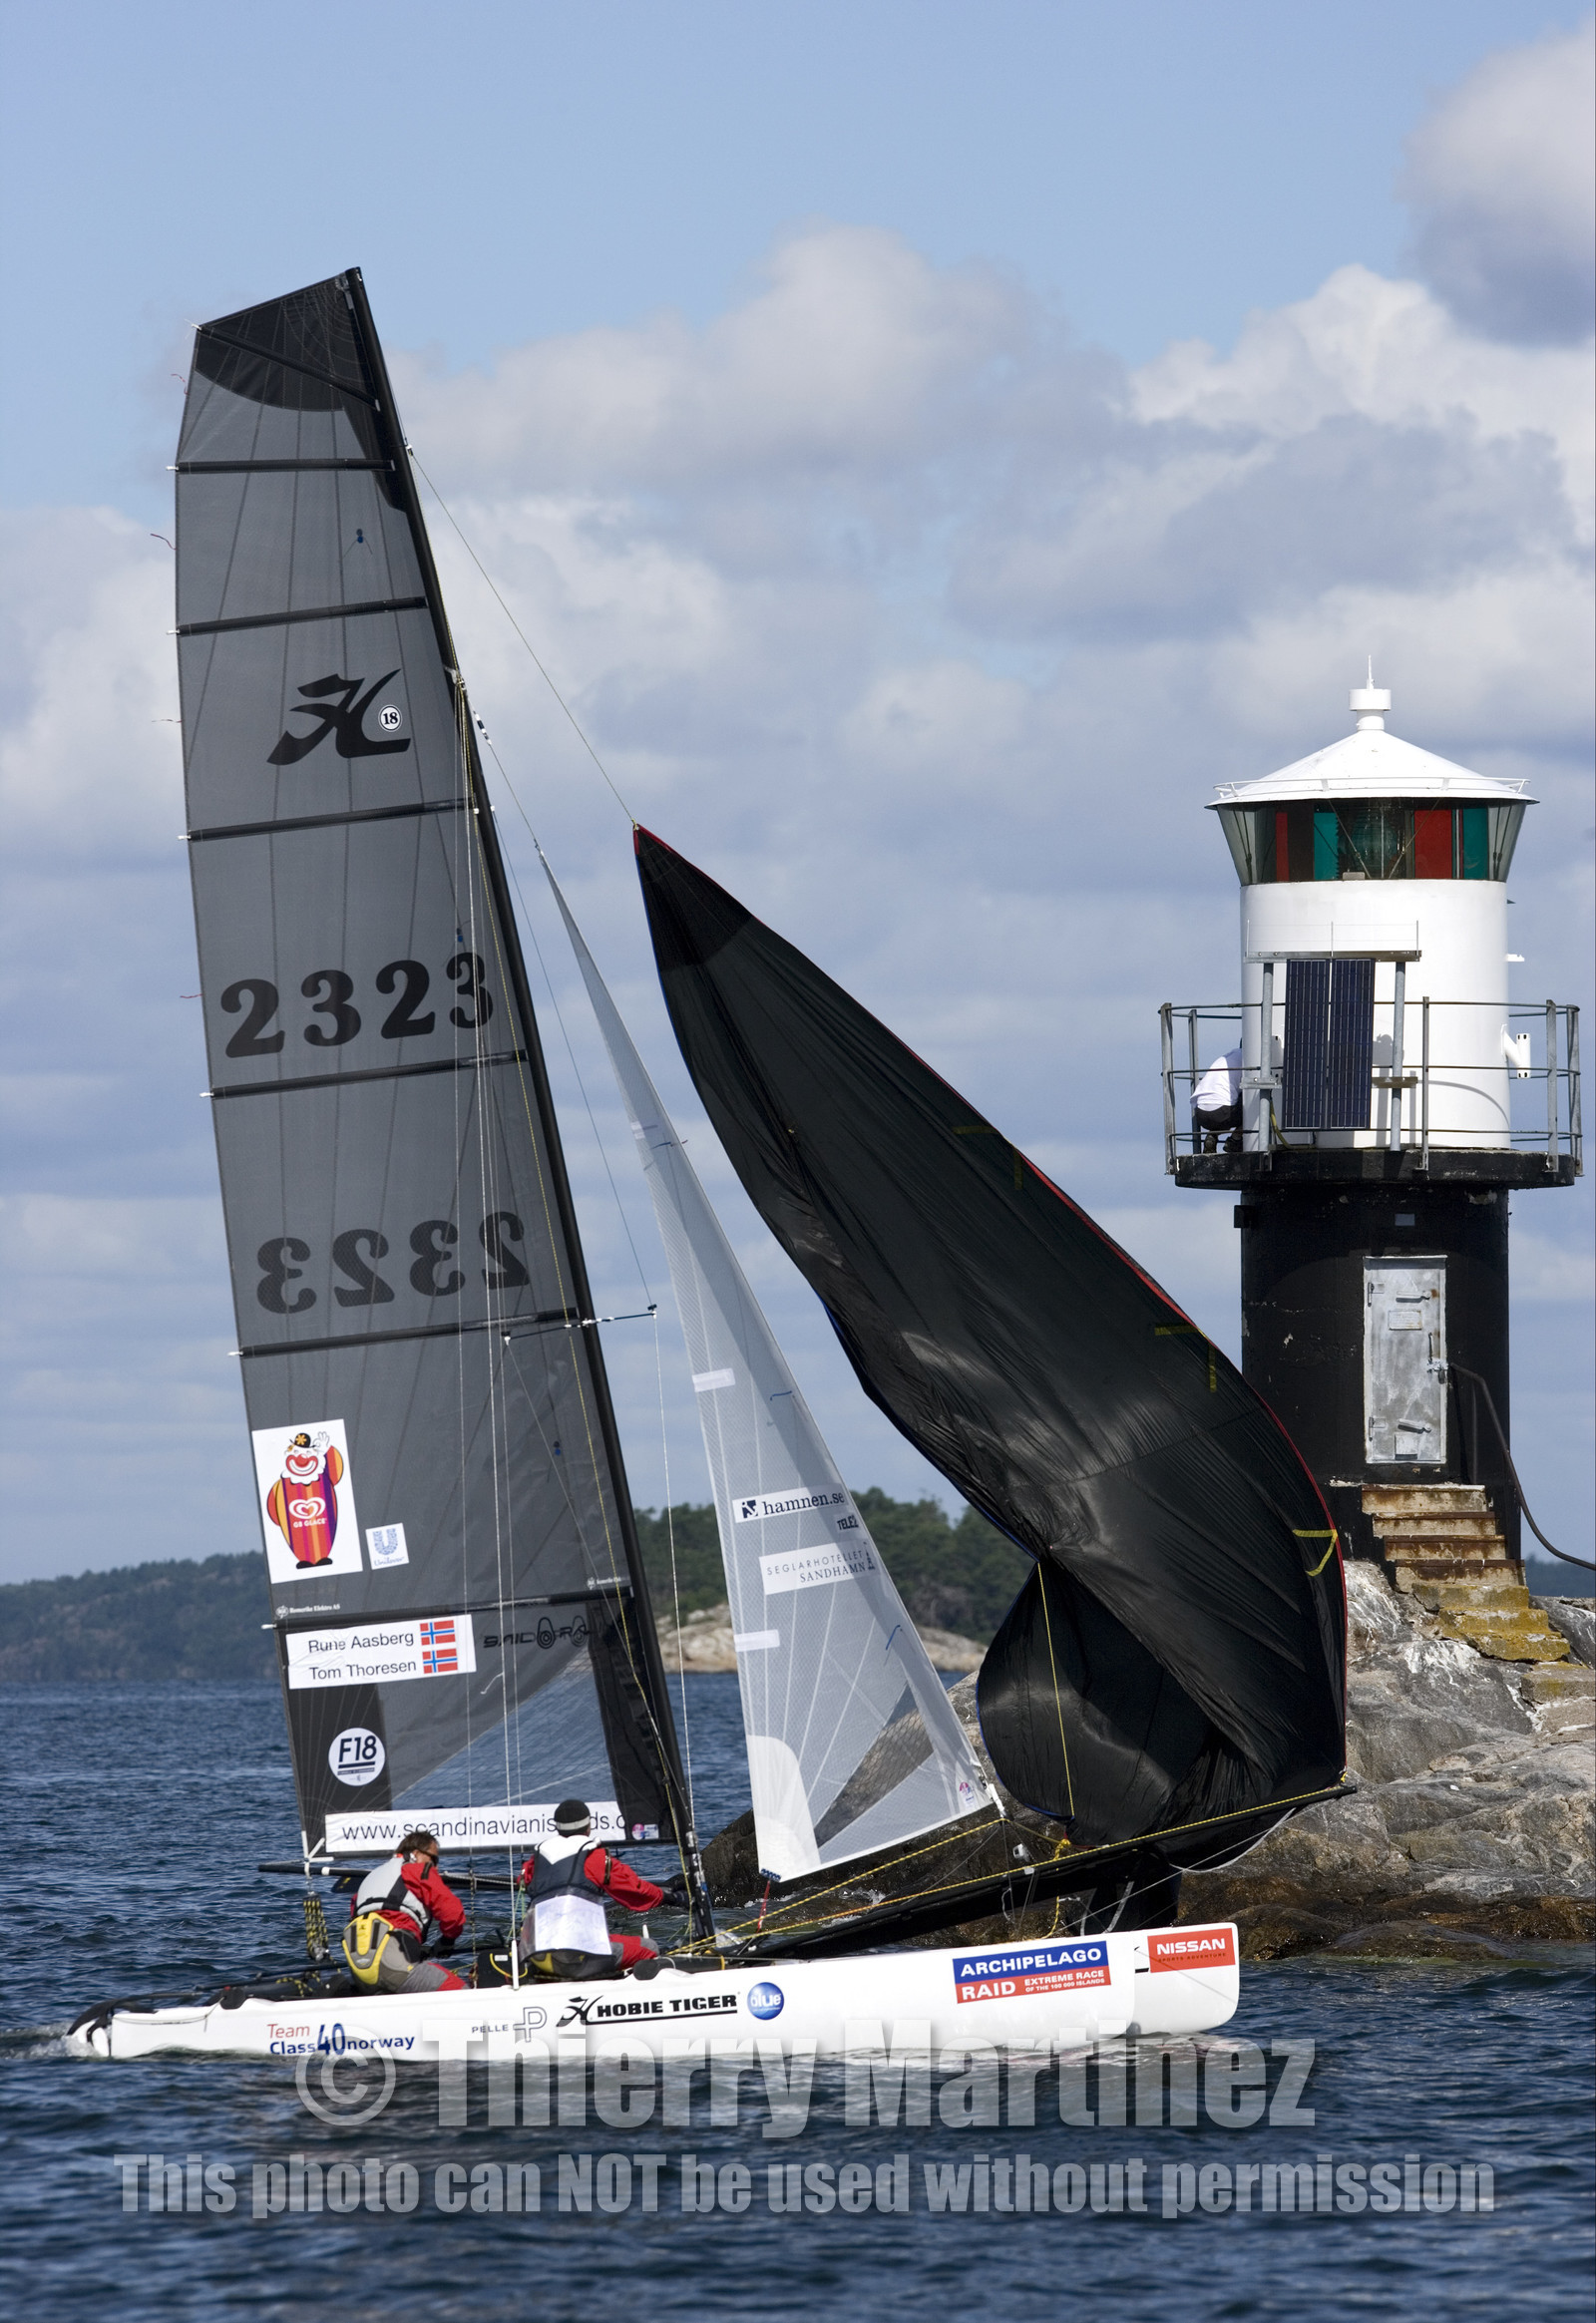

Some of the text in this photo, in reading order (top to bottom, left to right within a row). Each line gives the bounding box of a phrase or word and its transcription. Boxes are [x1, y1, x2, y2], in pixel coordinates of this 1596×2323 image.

[382, 711, 399, 725] 18
[219, 952, 495, 1058] 2323
[762, 1492, 845, 1516] hamnen.se
[837, 1514, 859, 1531] TELE2
[767, 1550, 864, 1576] SEGLARHOTELLET
[800, 1561, 866, 1583] SANDHAMN
[308, 1632, 414, 1654] Rune Aasberg
[309, 1661, 417, 1681] Tom Thoresen
[338, 1735, 377, 1762] F18
[1156, 1938, 1226, 1956] NISSAN
[961, 1948, 1102, 1978] ARCHIPELAGO
[1024, 1970, 1104, 1986] EXTREME RACE
[750, 1993, 782, 2008] blue
[962, 1980, 1016, 2001] RAID
[597, 1995, 738, 2018] HOBIE TIGER
[267, 2023, 310, 2040] Team
[471, 2023, 509, 2034] PELLE
